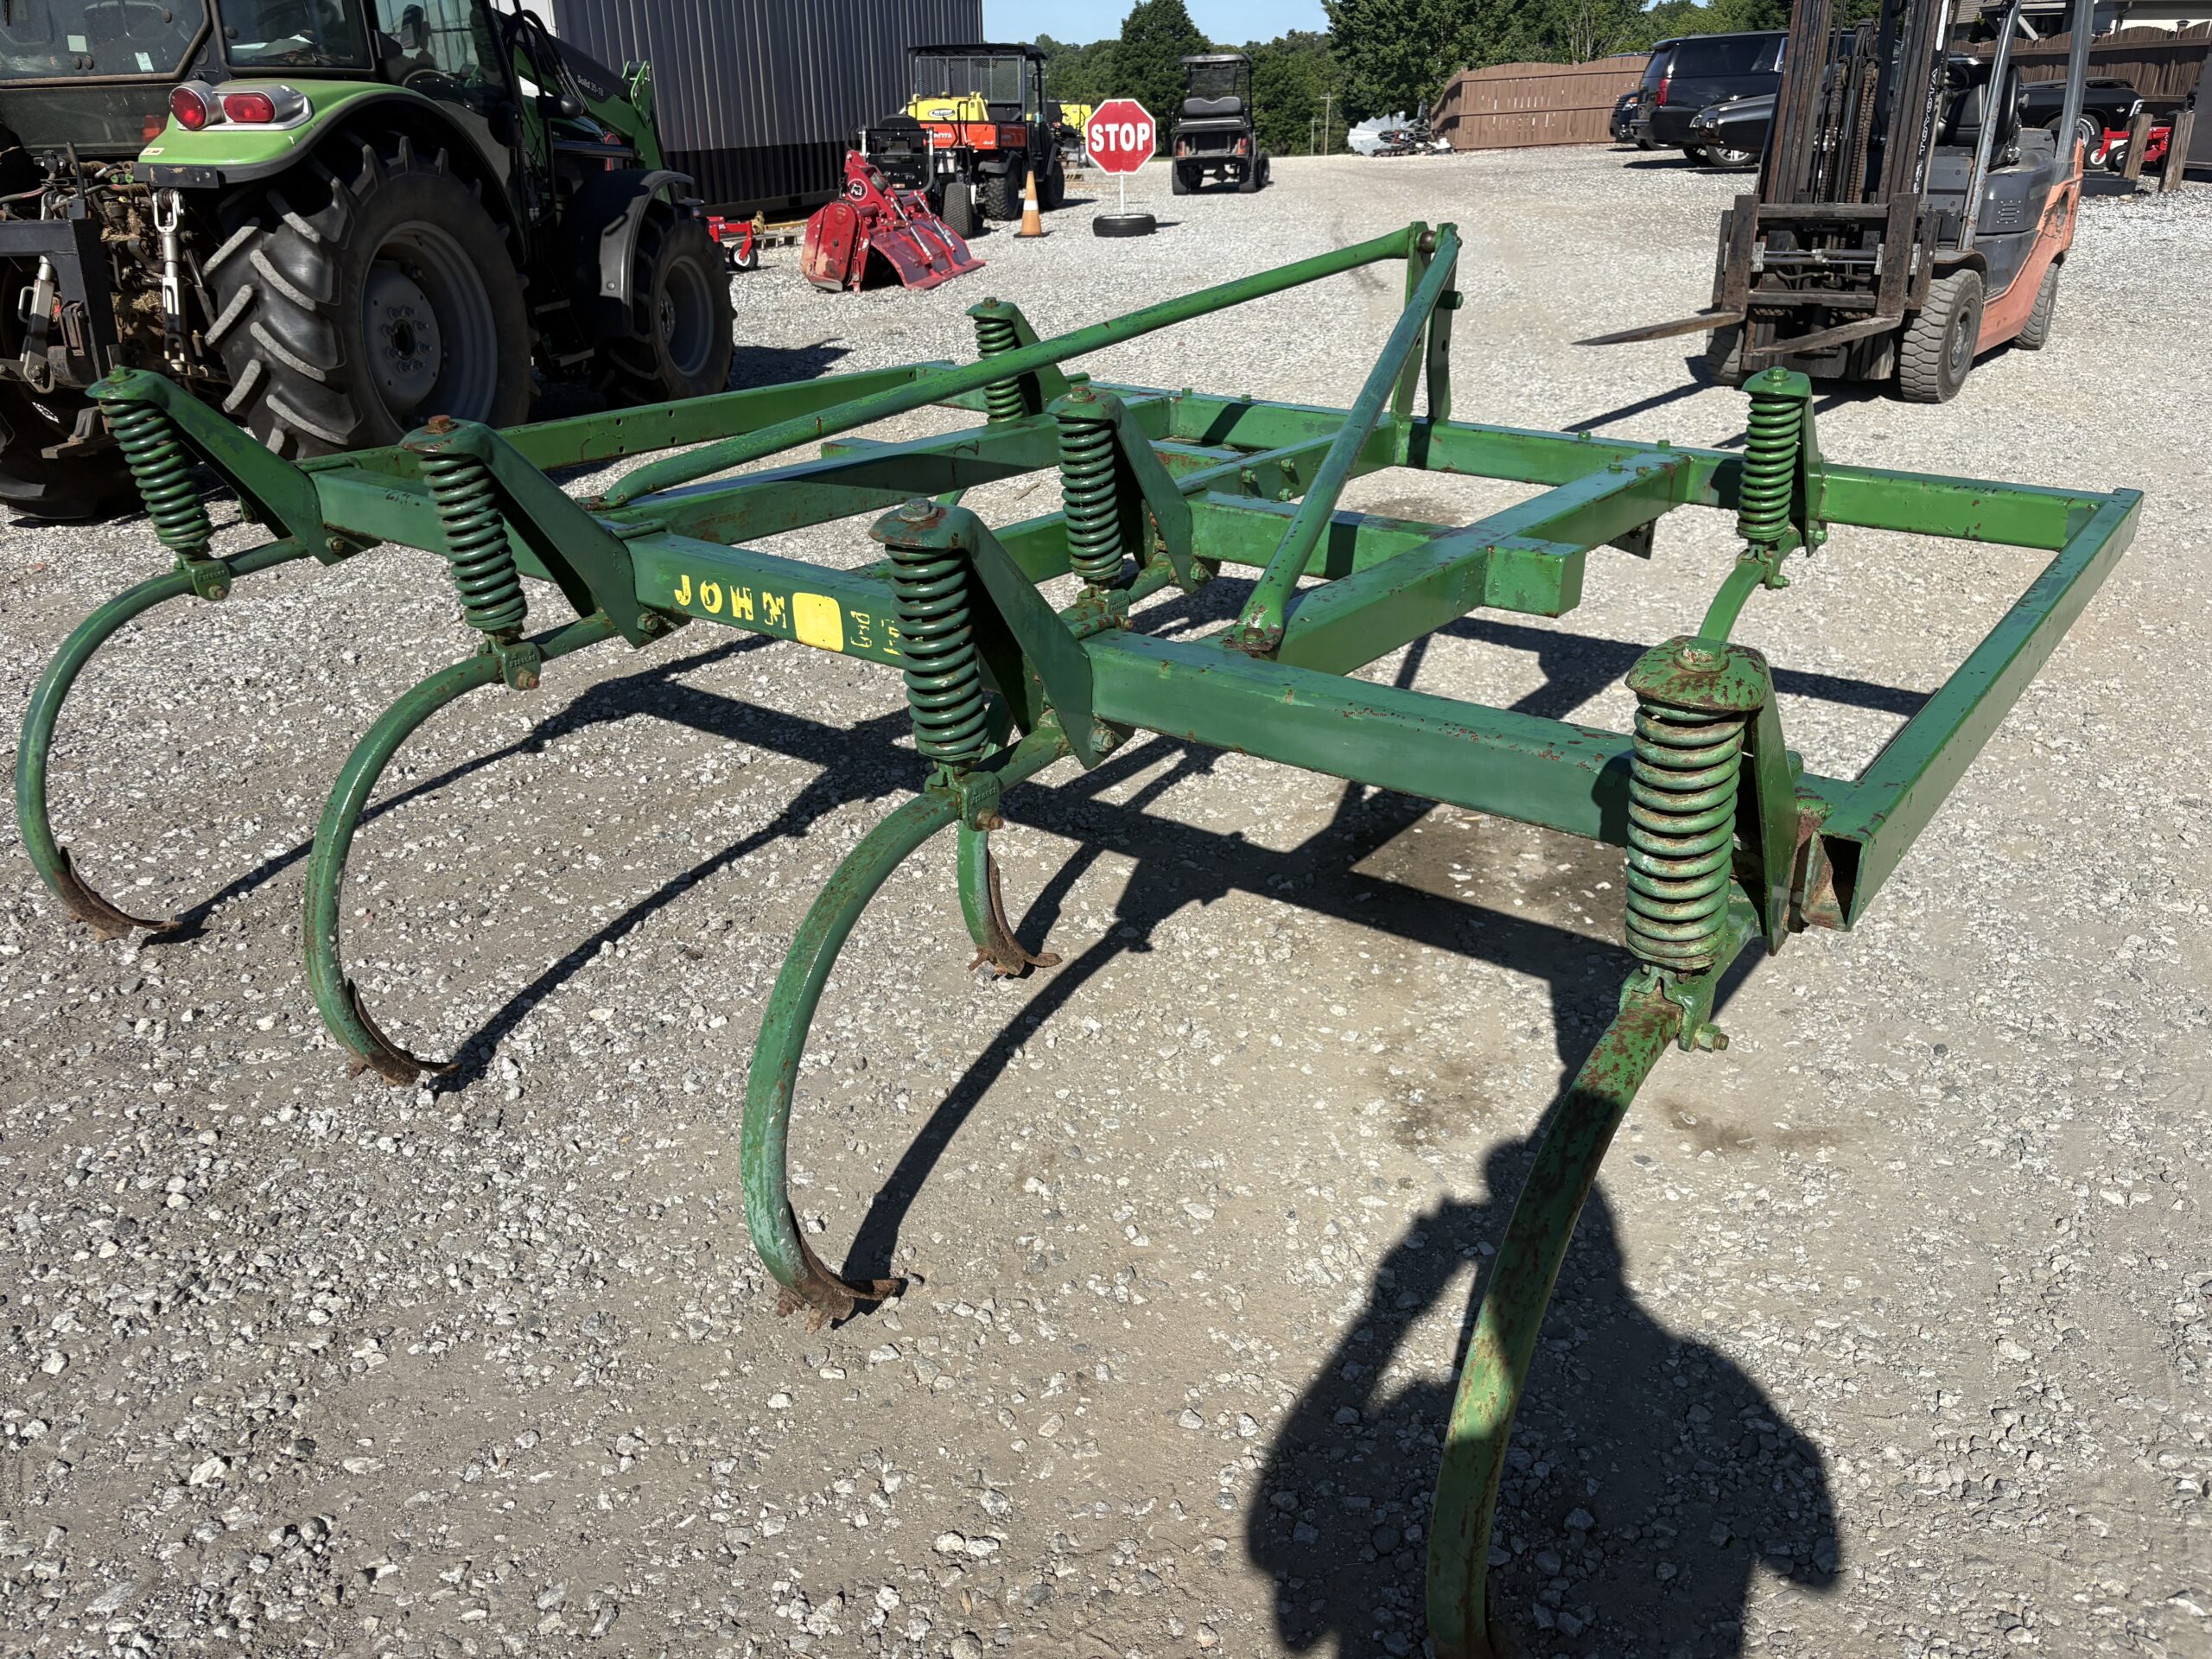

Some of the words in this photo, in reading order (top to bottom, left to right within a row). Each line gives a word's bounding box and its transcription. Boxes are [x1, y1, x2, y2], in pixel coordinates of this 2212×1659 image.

[577, 74, 591, 89] Solid
[1918, 67, 1938, 156] TOYOTA
[1090, 123, 1151, 153] STOP
